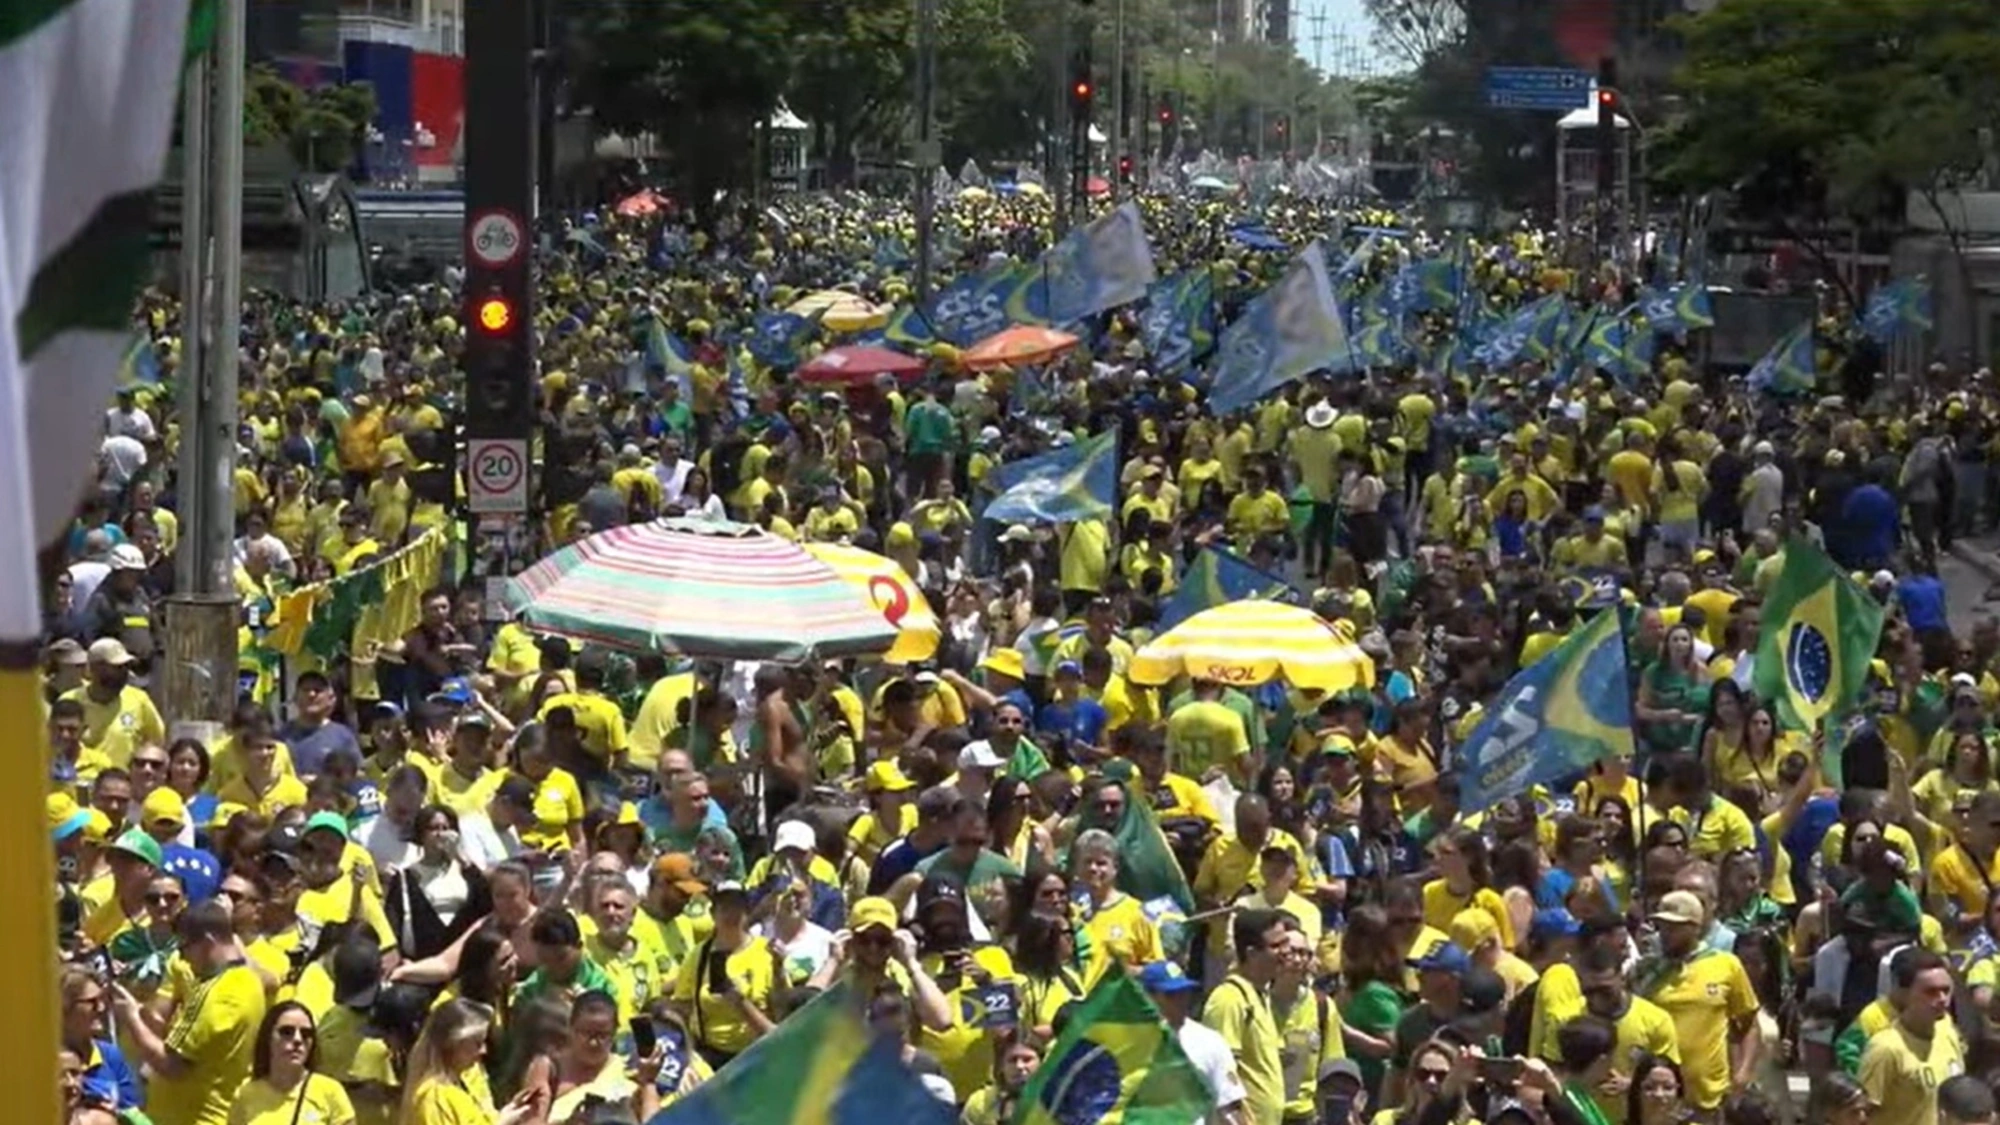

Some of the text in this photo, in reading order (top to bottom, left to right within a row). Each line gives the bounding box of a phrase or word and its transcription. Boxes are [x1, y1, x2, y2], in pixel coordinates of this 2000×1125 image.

[483, 455, 513, 477] 20
[1208, 665, 1256, 681] SKOL
[985, 994, 1011, 1012] 22
